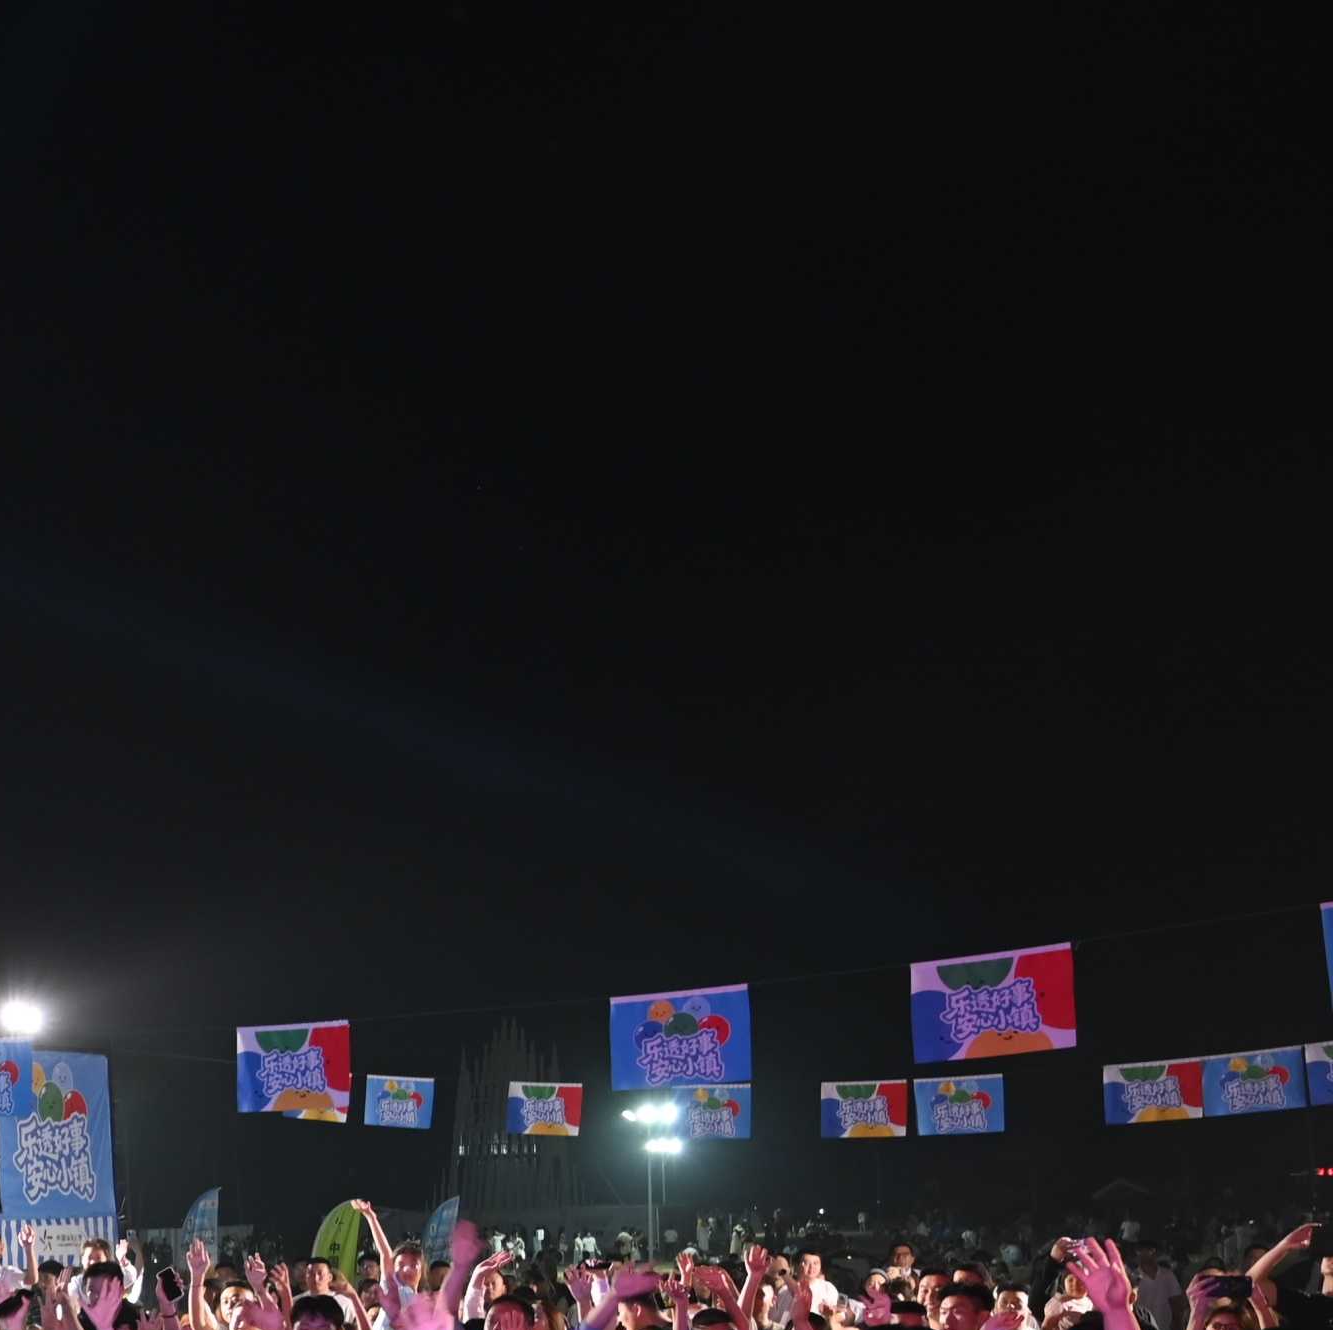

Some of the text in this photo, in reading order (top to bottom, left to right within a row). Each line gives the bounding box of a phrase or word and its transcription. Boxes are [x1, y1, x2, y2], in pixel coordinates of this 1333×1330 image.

[943, 980, 1035, 1021] 乐透好事
[953, 1007, 1039, 1039] 安心小镇
[641, 1032, 719, 1063] 乐透好事
[260, 1050, 322, 1077] 乐透好事
[648, 1054, 722, 1081] 安心小镇
[267, 1071, 325, 1094] 安心小镇
[17, 1117, 87, 1164] 乐透好事
[28, 1154, 94, 1198] 安心小镇
